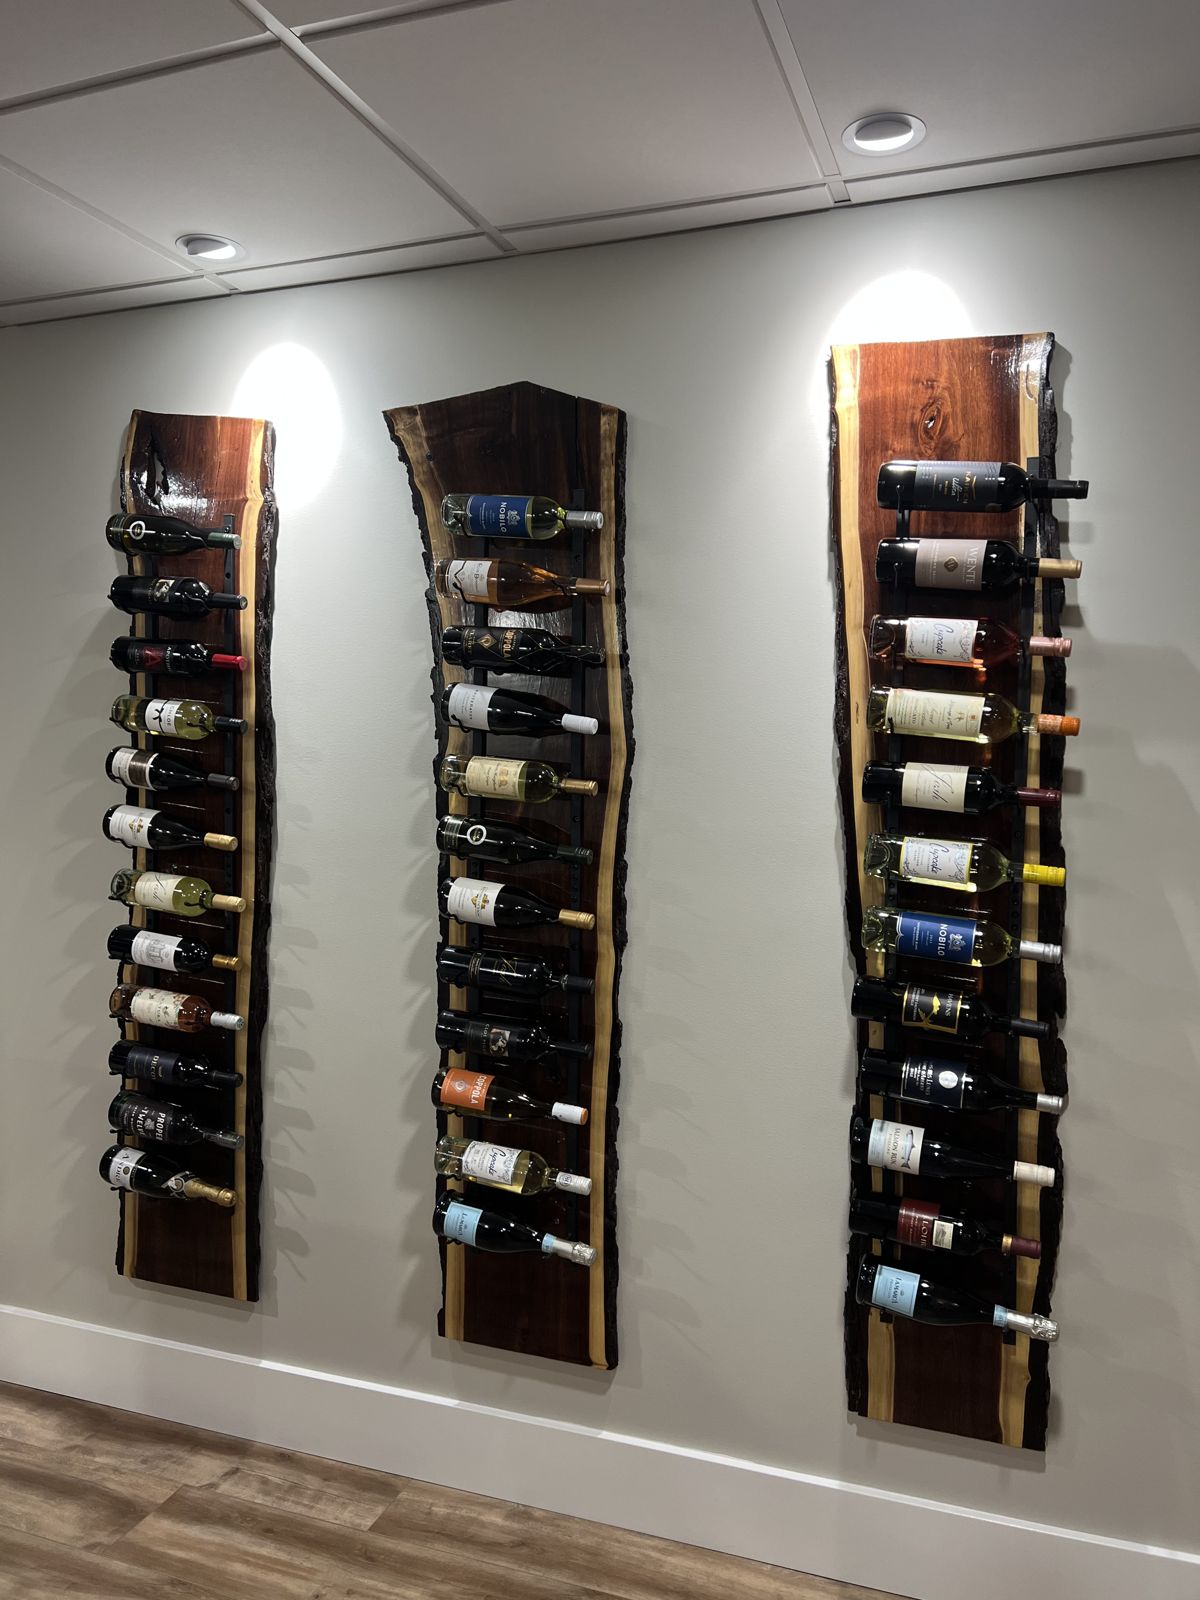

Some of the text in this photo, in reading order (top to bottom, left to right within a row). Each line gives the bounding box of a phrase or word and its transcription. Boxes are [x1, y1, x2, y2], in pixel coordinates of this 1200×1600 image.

[499, 502, 507, 532] NOBILO
[966, 547, 979, 584] WENTE
[502, 630, 515, 657] COPPOLA
[933, 624, 954, 656] Cupcake
[920, 764, 954, 803] Josh
[928, 843, 949, 874] Cupcake
[937, 924, 948, 956] NOBILO
[470, 1076, 487, 1104] COPPOLA
[892, 1128, 901, 1151] SALMON
[488, 1148, 506, 1175] Cupcake
